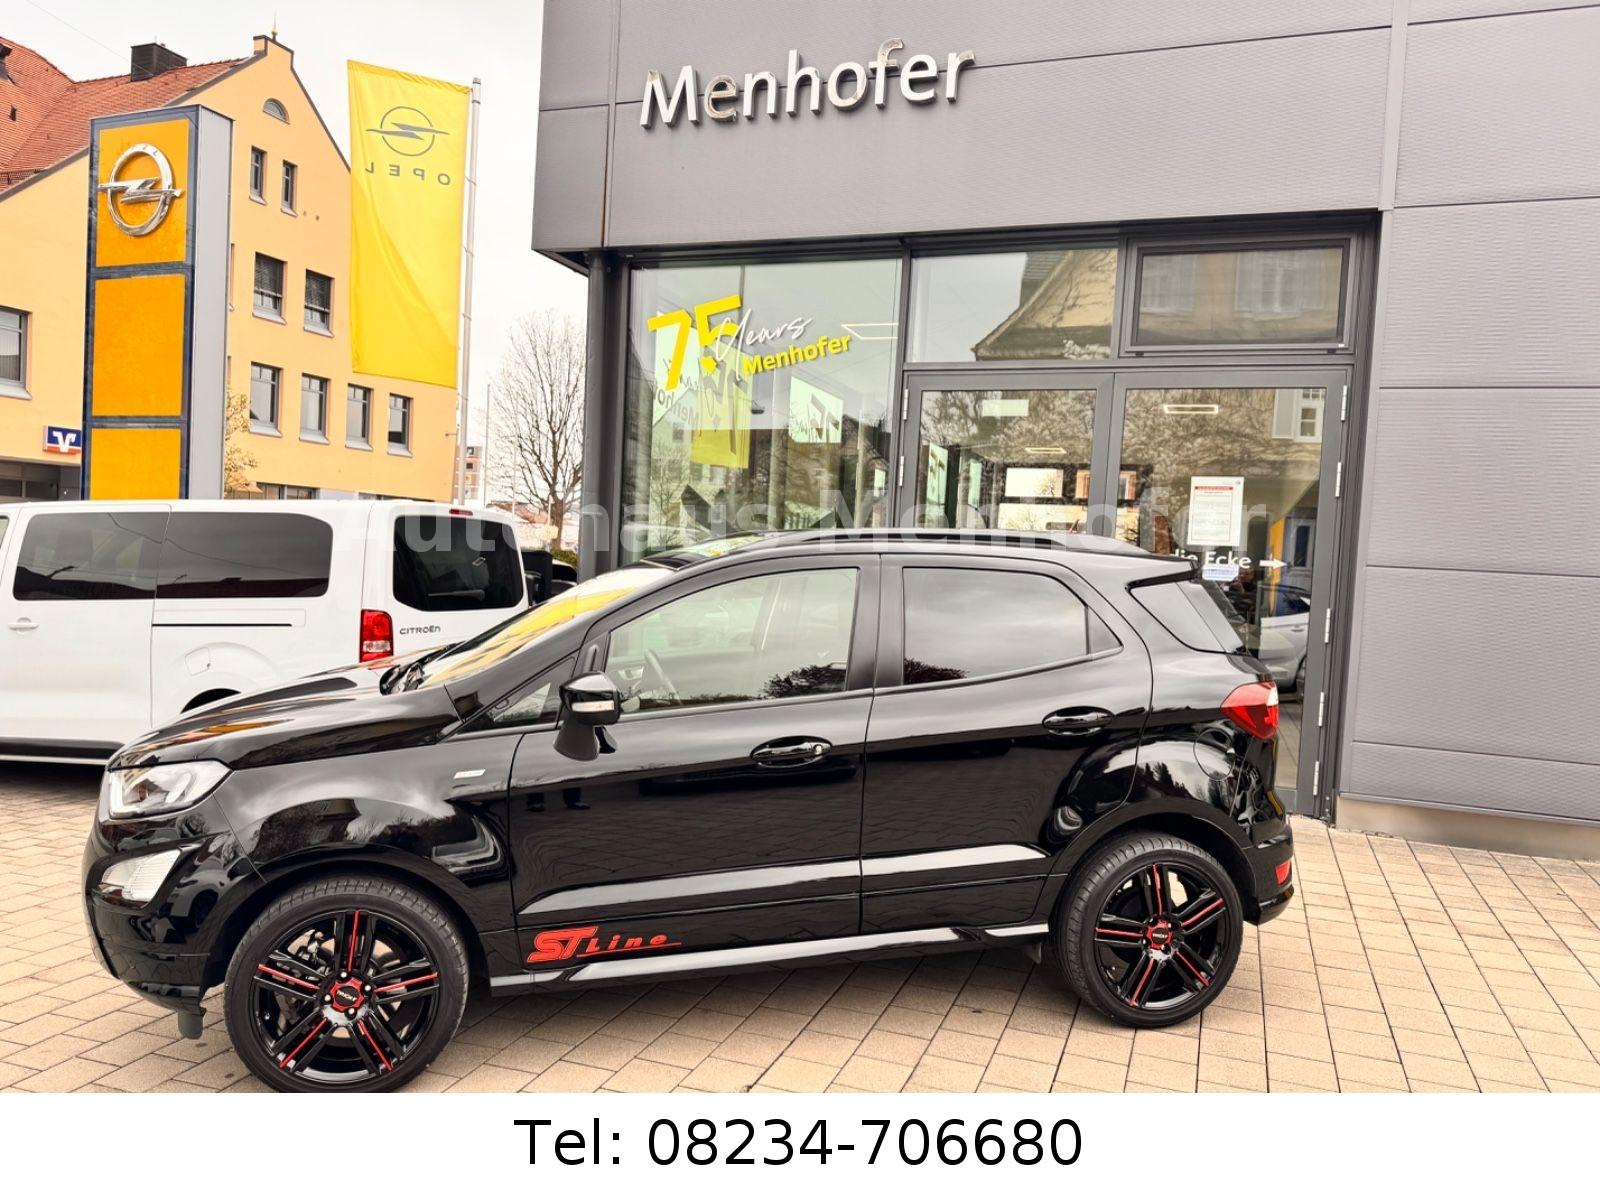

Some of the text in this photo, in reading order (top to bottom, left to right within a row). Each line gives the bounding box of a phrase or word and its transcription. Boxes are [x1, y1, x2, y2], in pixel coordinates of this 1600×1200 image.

[640, 38, 976, 129] Menhofer
[647, 294, 813, 391] 75 Years
[742, 335, 853, 376] Menhofer
